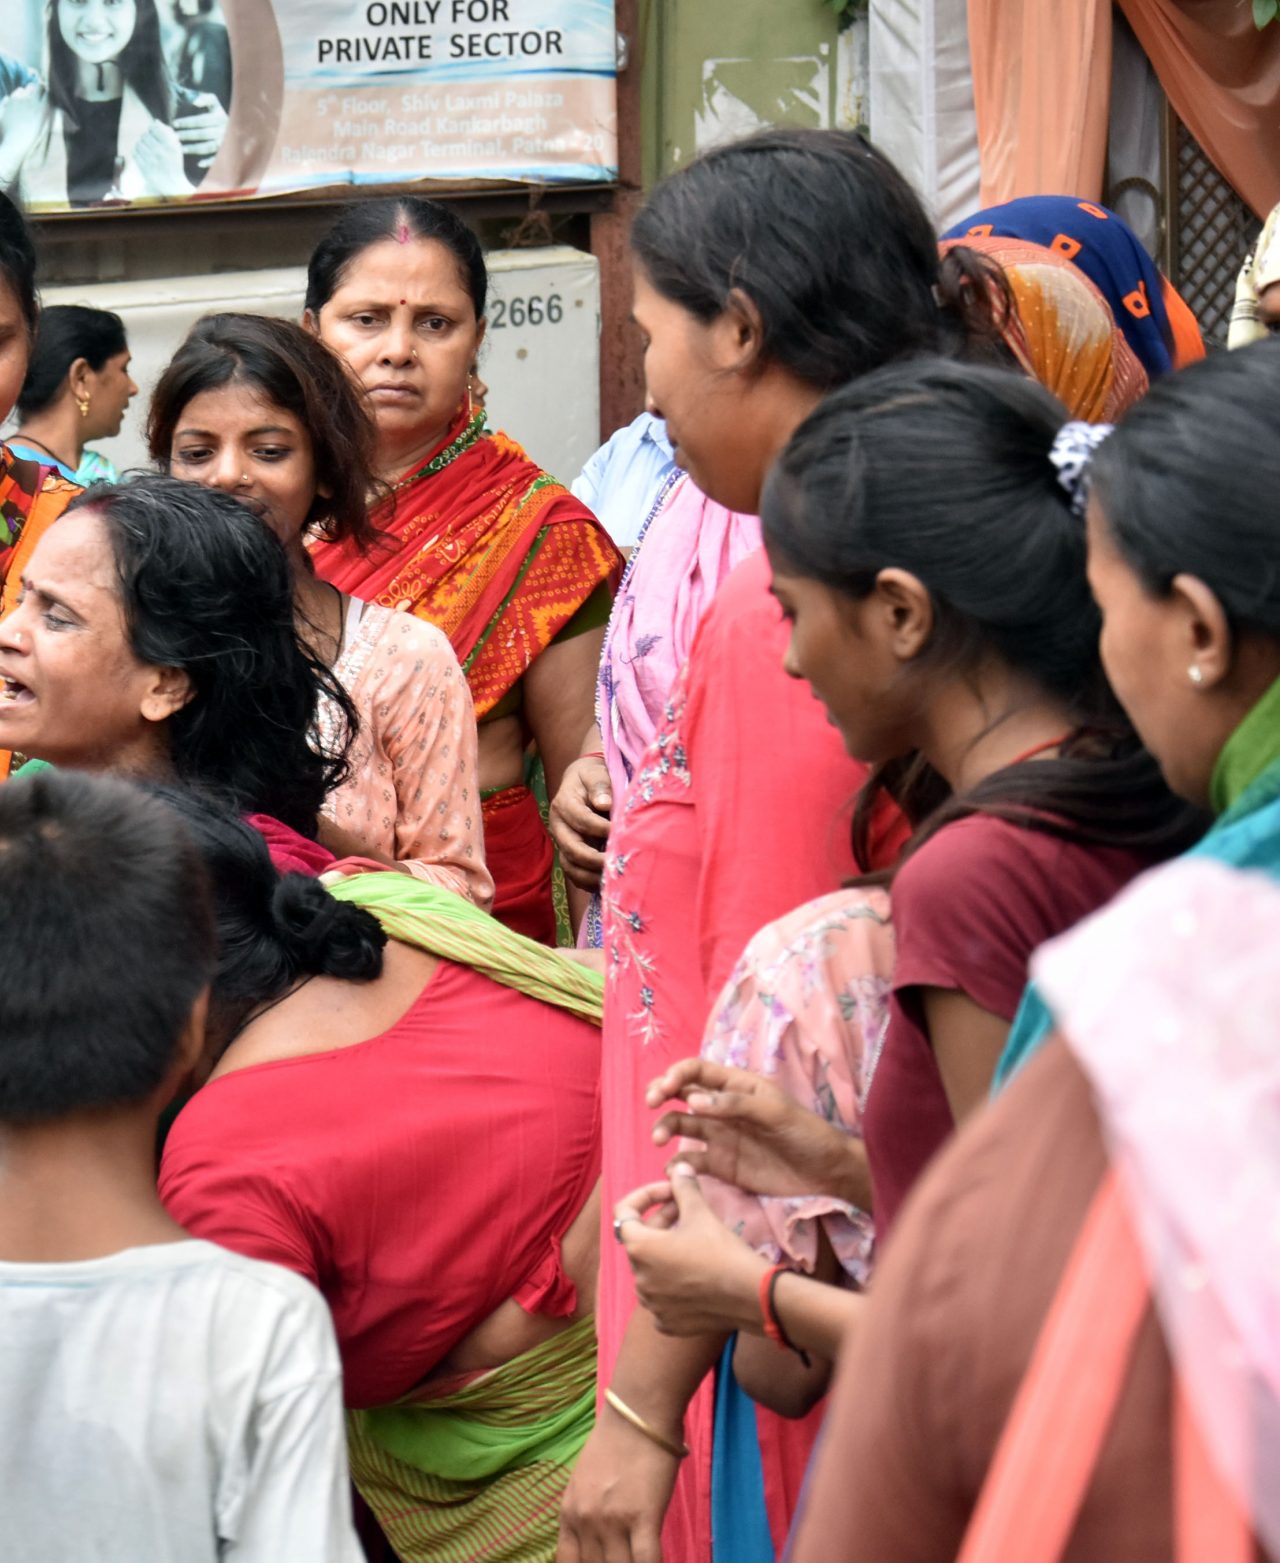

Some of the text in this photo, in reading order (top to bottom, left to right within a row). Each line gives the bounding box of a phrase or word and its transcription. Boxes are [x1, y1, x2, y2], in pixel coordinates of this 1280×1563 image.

[366, 0, 509, 26] ONLY FOR
[319, 30, 563, 63] PRIVATE SECTOR
[401, 94, 440, 113] Shiv
[445, 91, 500, 112] Laxmi
[333, 118, 379, 137] Main
[384, 117, 430, 135] Road
[361, 141, 415, 163] Nagar
[490, 294, 563, 329] 2666
